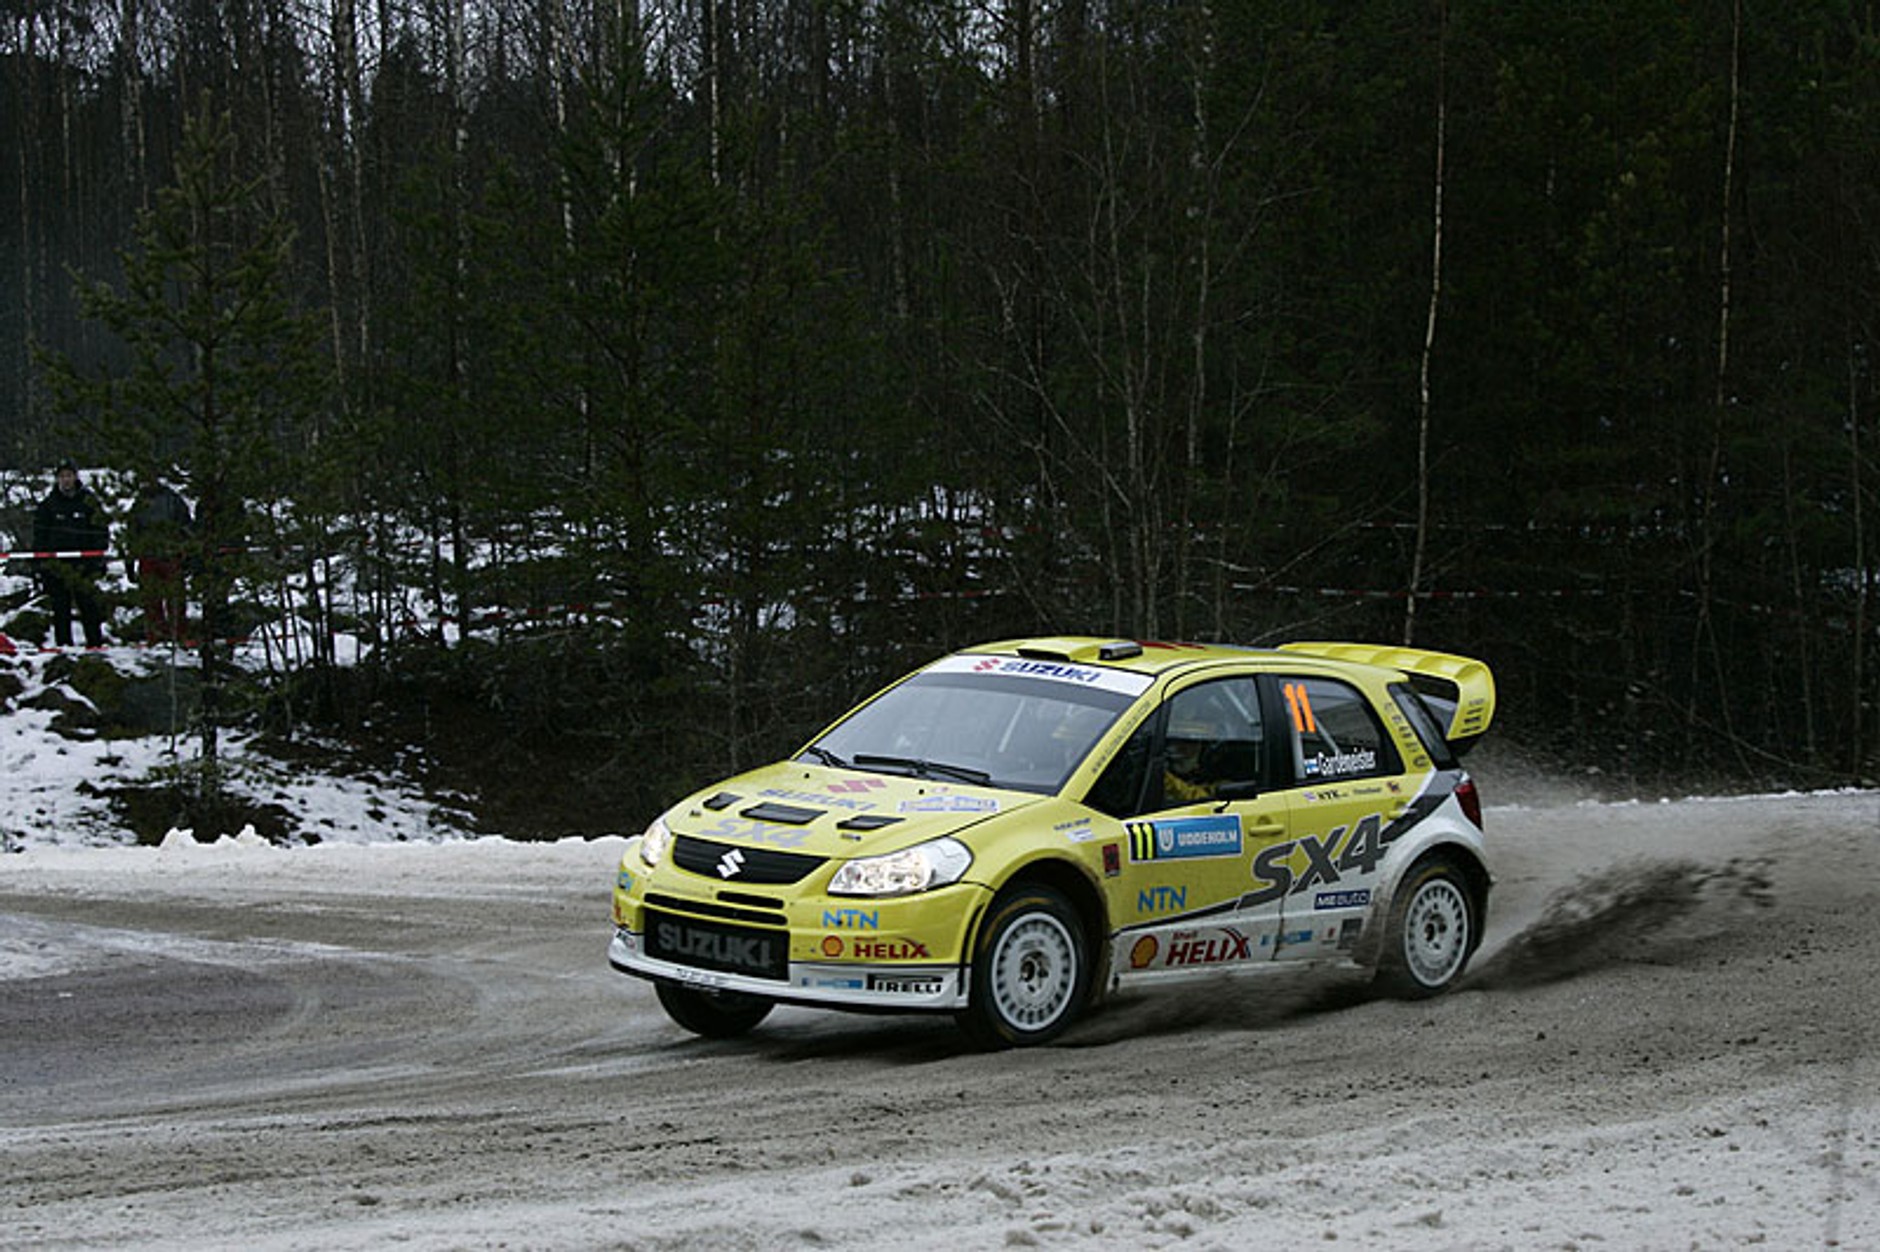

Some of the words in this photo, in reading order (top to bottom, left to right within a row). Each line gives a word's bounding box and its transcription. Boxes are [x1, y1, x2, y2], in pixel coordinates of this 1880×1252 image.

[1000, 661, 1100, 682] SUZUKI
[1284, 683, 1317, 733] 11
[757, 789, 877, 812] SUZUKI
[702, 818, 813, 849] SX4
[1132, 822, 1153, 860] 11
[1237, 812, 1389, 911] SX4
[1137, 886, 1187, 912] NTN
[822, 908, 879, 929] NTN
[656, 921, 773, 969] SUZUKI
[853, 939, 931, 959] HELIX
[1165, 931, 1252, 967] HELIX
[866, 972, 944, 994] PIRELLI
